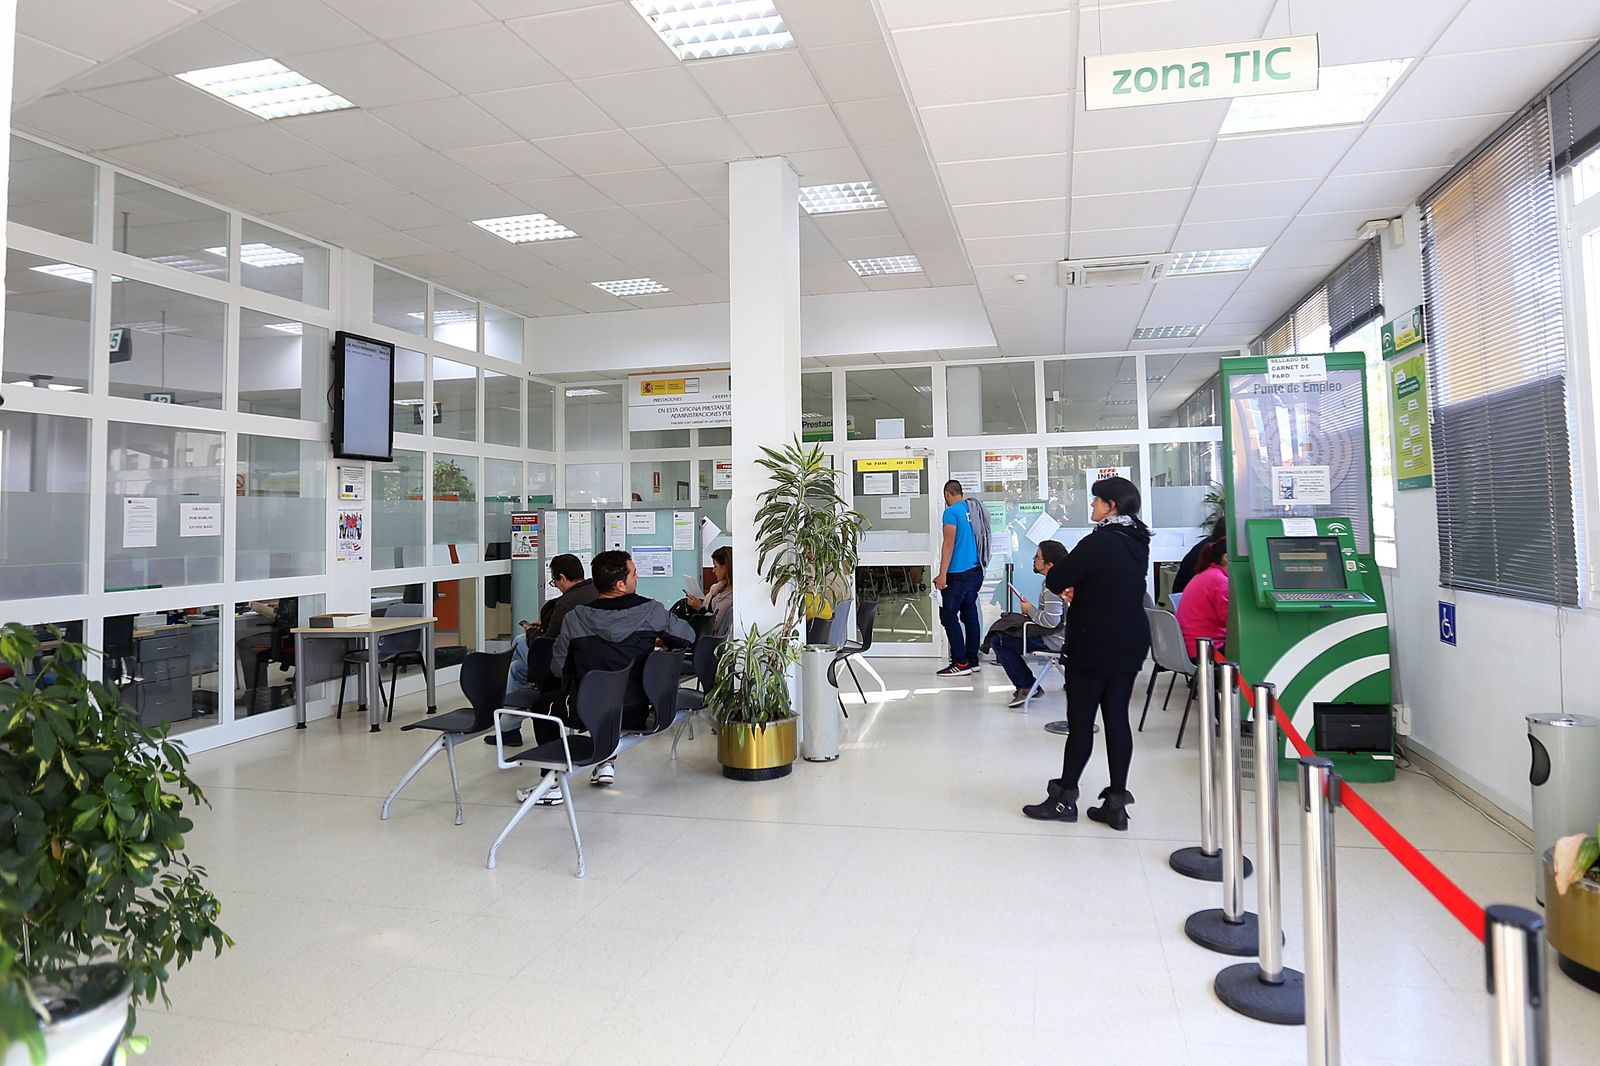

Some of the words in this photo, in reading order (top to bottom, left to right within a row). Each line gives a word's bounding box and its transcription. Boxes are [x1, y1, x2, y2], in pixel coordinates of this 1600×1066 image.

[1112, 60, 1210, 95] zona
[1225, 46, 1292, 84] TIC
[1254, 383, 1286, 394] Punto
[1287, 383, 1300, 393] de
[1303, 381, 1342, 394] Empleo
[802, 419, 851, 428] Prestacis
